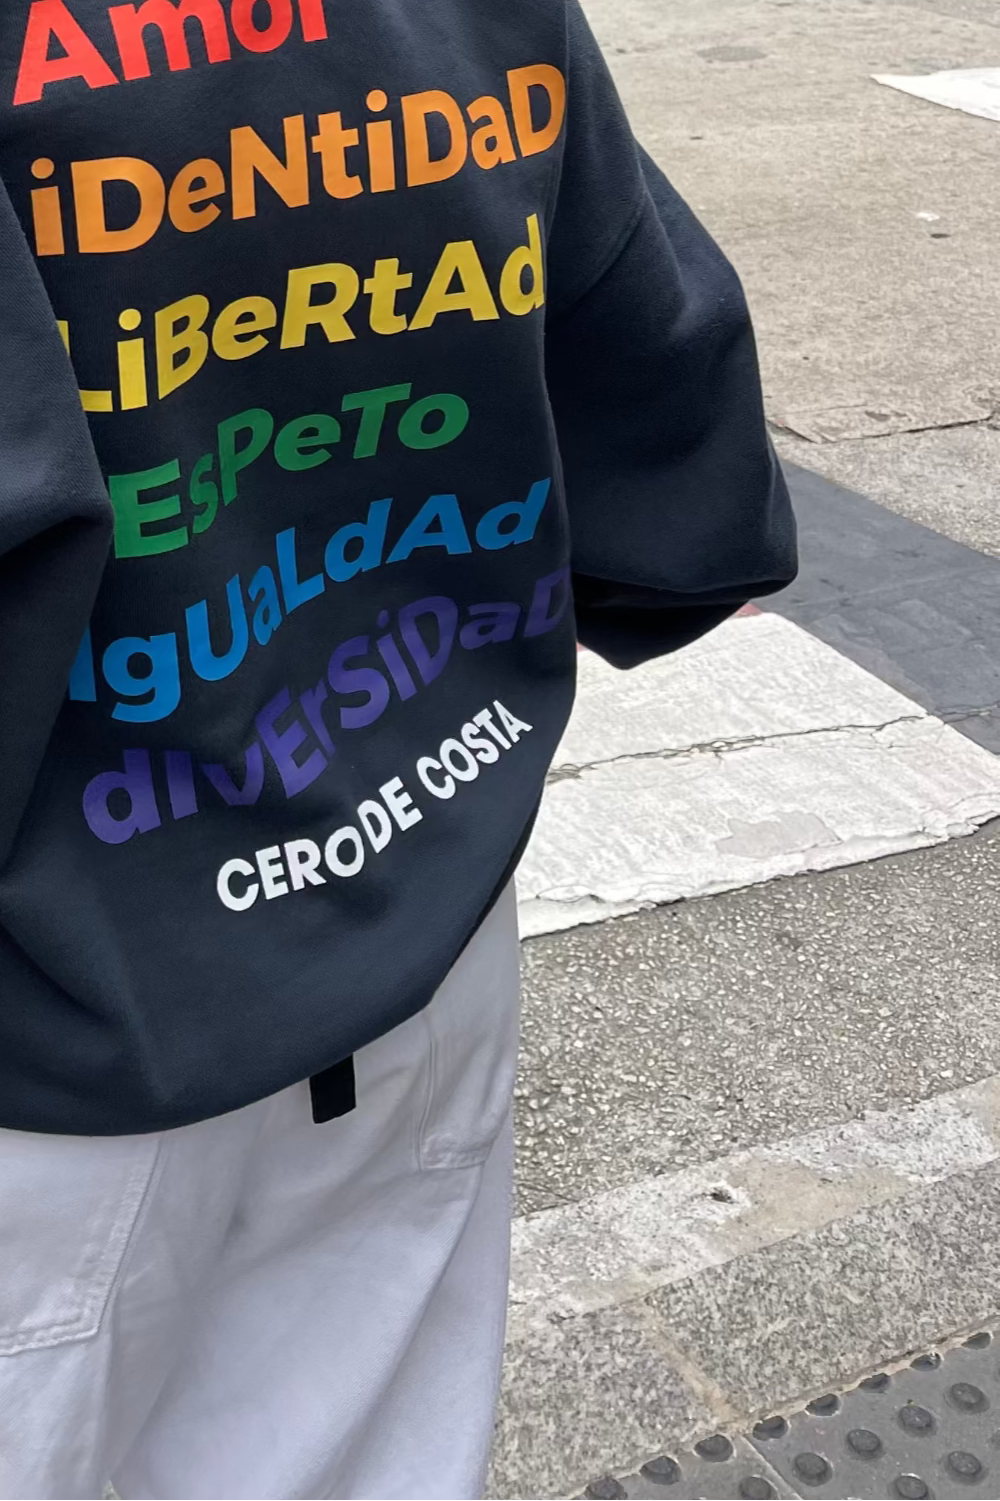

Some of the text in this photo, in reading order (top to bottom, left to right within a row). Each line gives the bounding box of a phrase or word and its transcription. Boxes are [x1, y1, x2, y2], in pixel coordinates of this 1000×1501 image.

[30, 63, 566, 257] iDeNtiDaD
[107, 382, 470, 559] EsPeTo
[416, 700, 534, 800] COSTA
